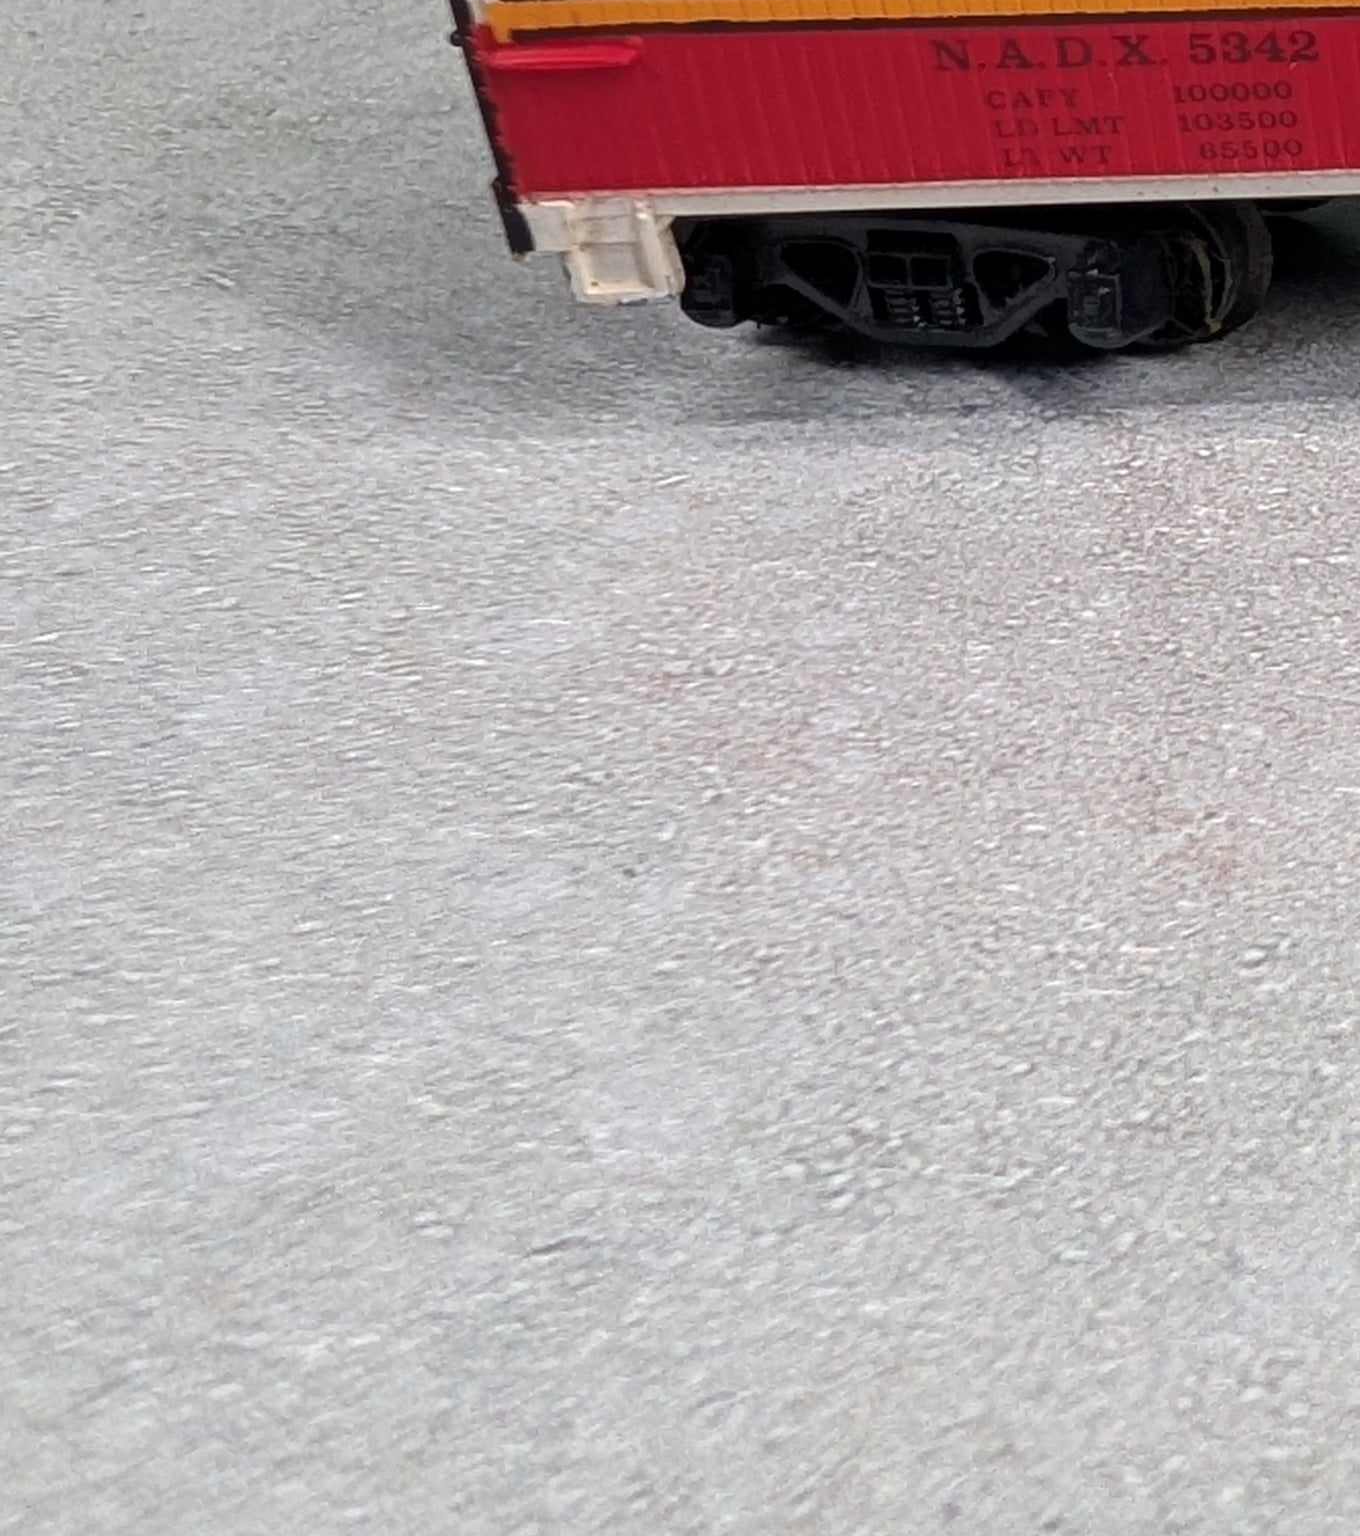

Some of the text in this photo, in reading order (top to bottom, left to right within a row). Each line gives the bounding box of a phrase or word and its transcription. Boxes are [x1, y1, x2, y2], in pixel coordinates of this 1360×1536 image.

[1187, 29, 1321, 64] 5342
[1173, 79, 1294, 104] 100000
[1051, 115, 1125, 137] LMT
[1178, 109, 1299, 133] 103500
[1058, 144, 1112, 165] WT
